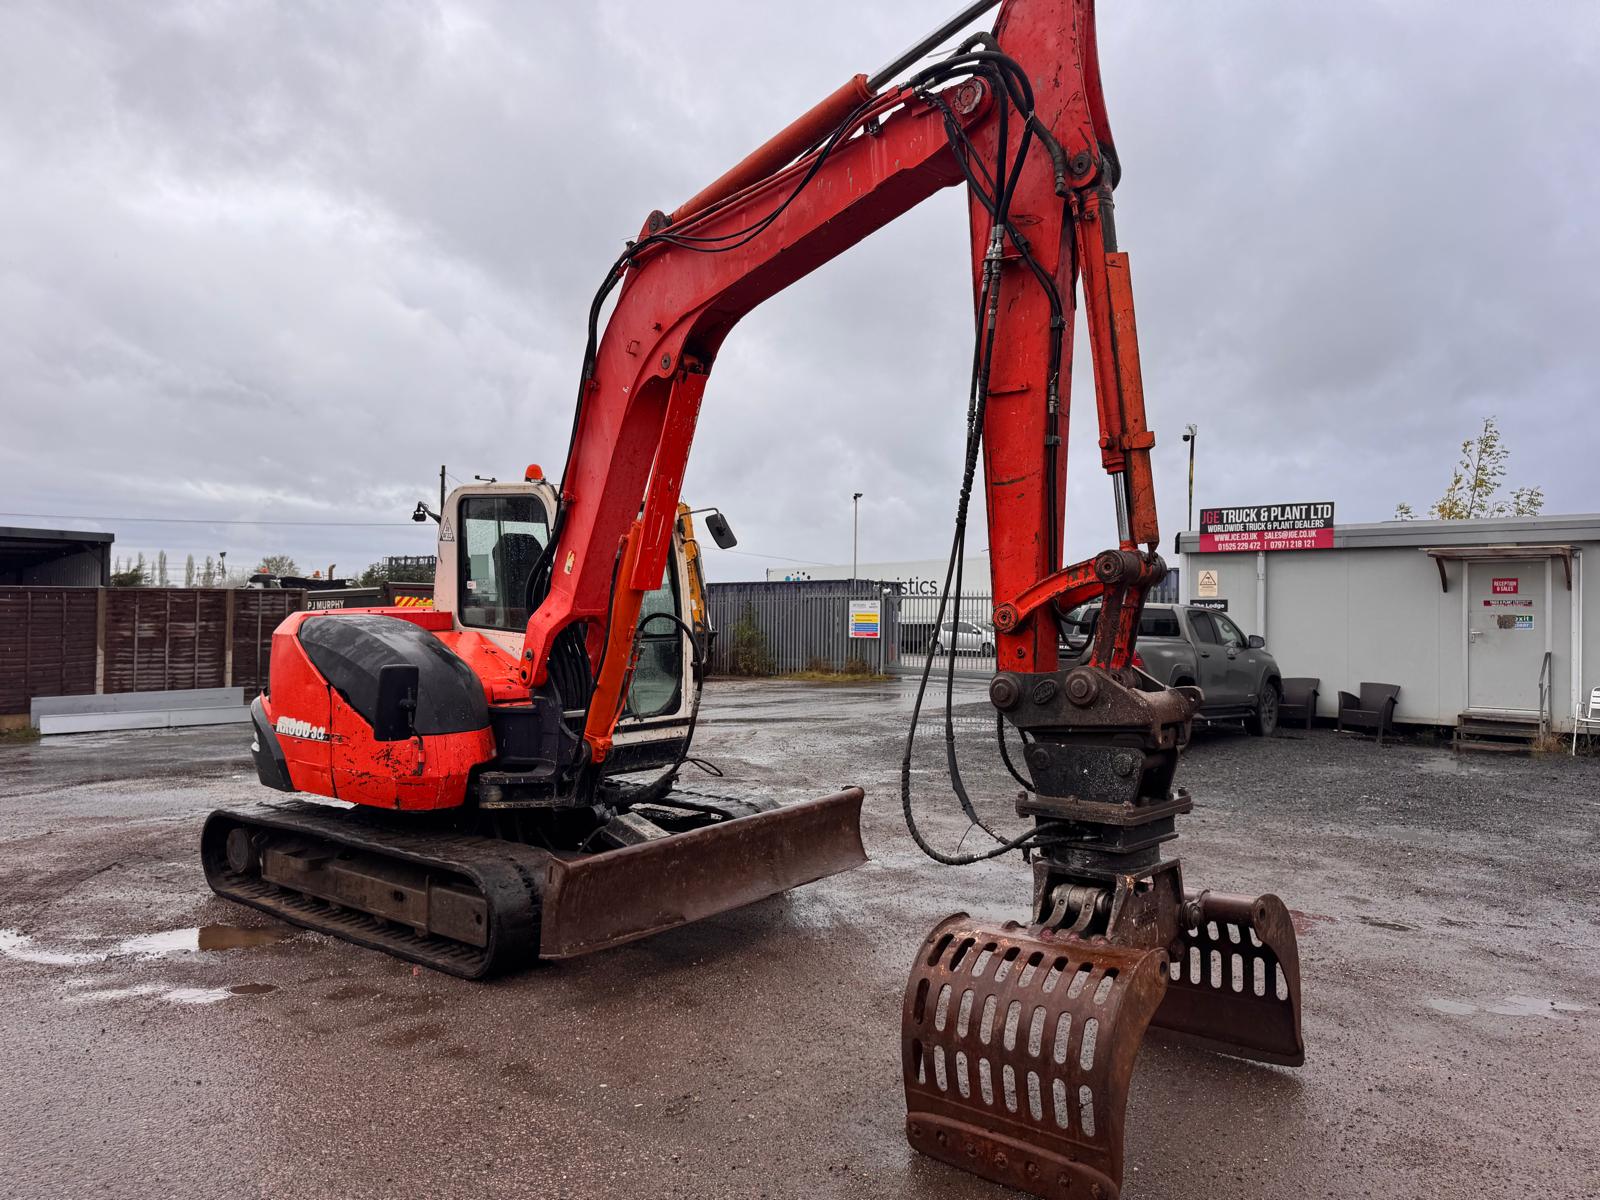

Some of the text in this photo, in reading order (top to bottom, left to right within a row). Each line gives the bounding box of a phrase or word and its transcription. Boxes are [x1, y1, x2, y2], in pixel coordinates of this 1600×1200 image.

[1221, 508, 1258, 524] TRUCK
[1260, 507, 1268, 522] &
[1270, 505, 1308, 521] PLANT
[1310, 504, 1332, 519] LTD
[1207, 519, 1324, 533] WORLDWIDE TRUCK & PLANT DEALERS
[316, 599, 345, 610] MURPHY
[1205, 602, 1225, 610] Lodge
